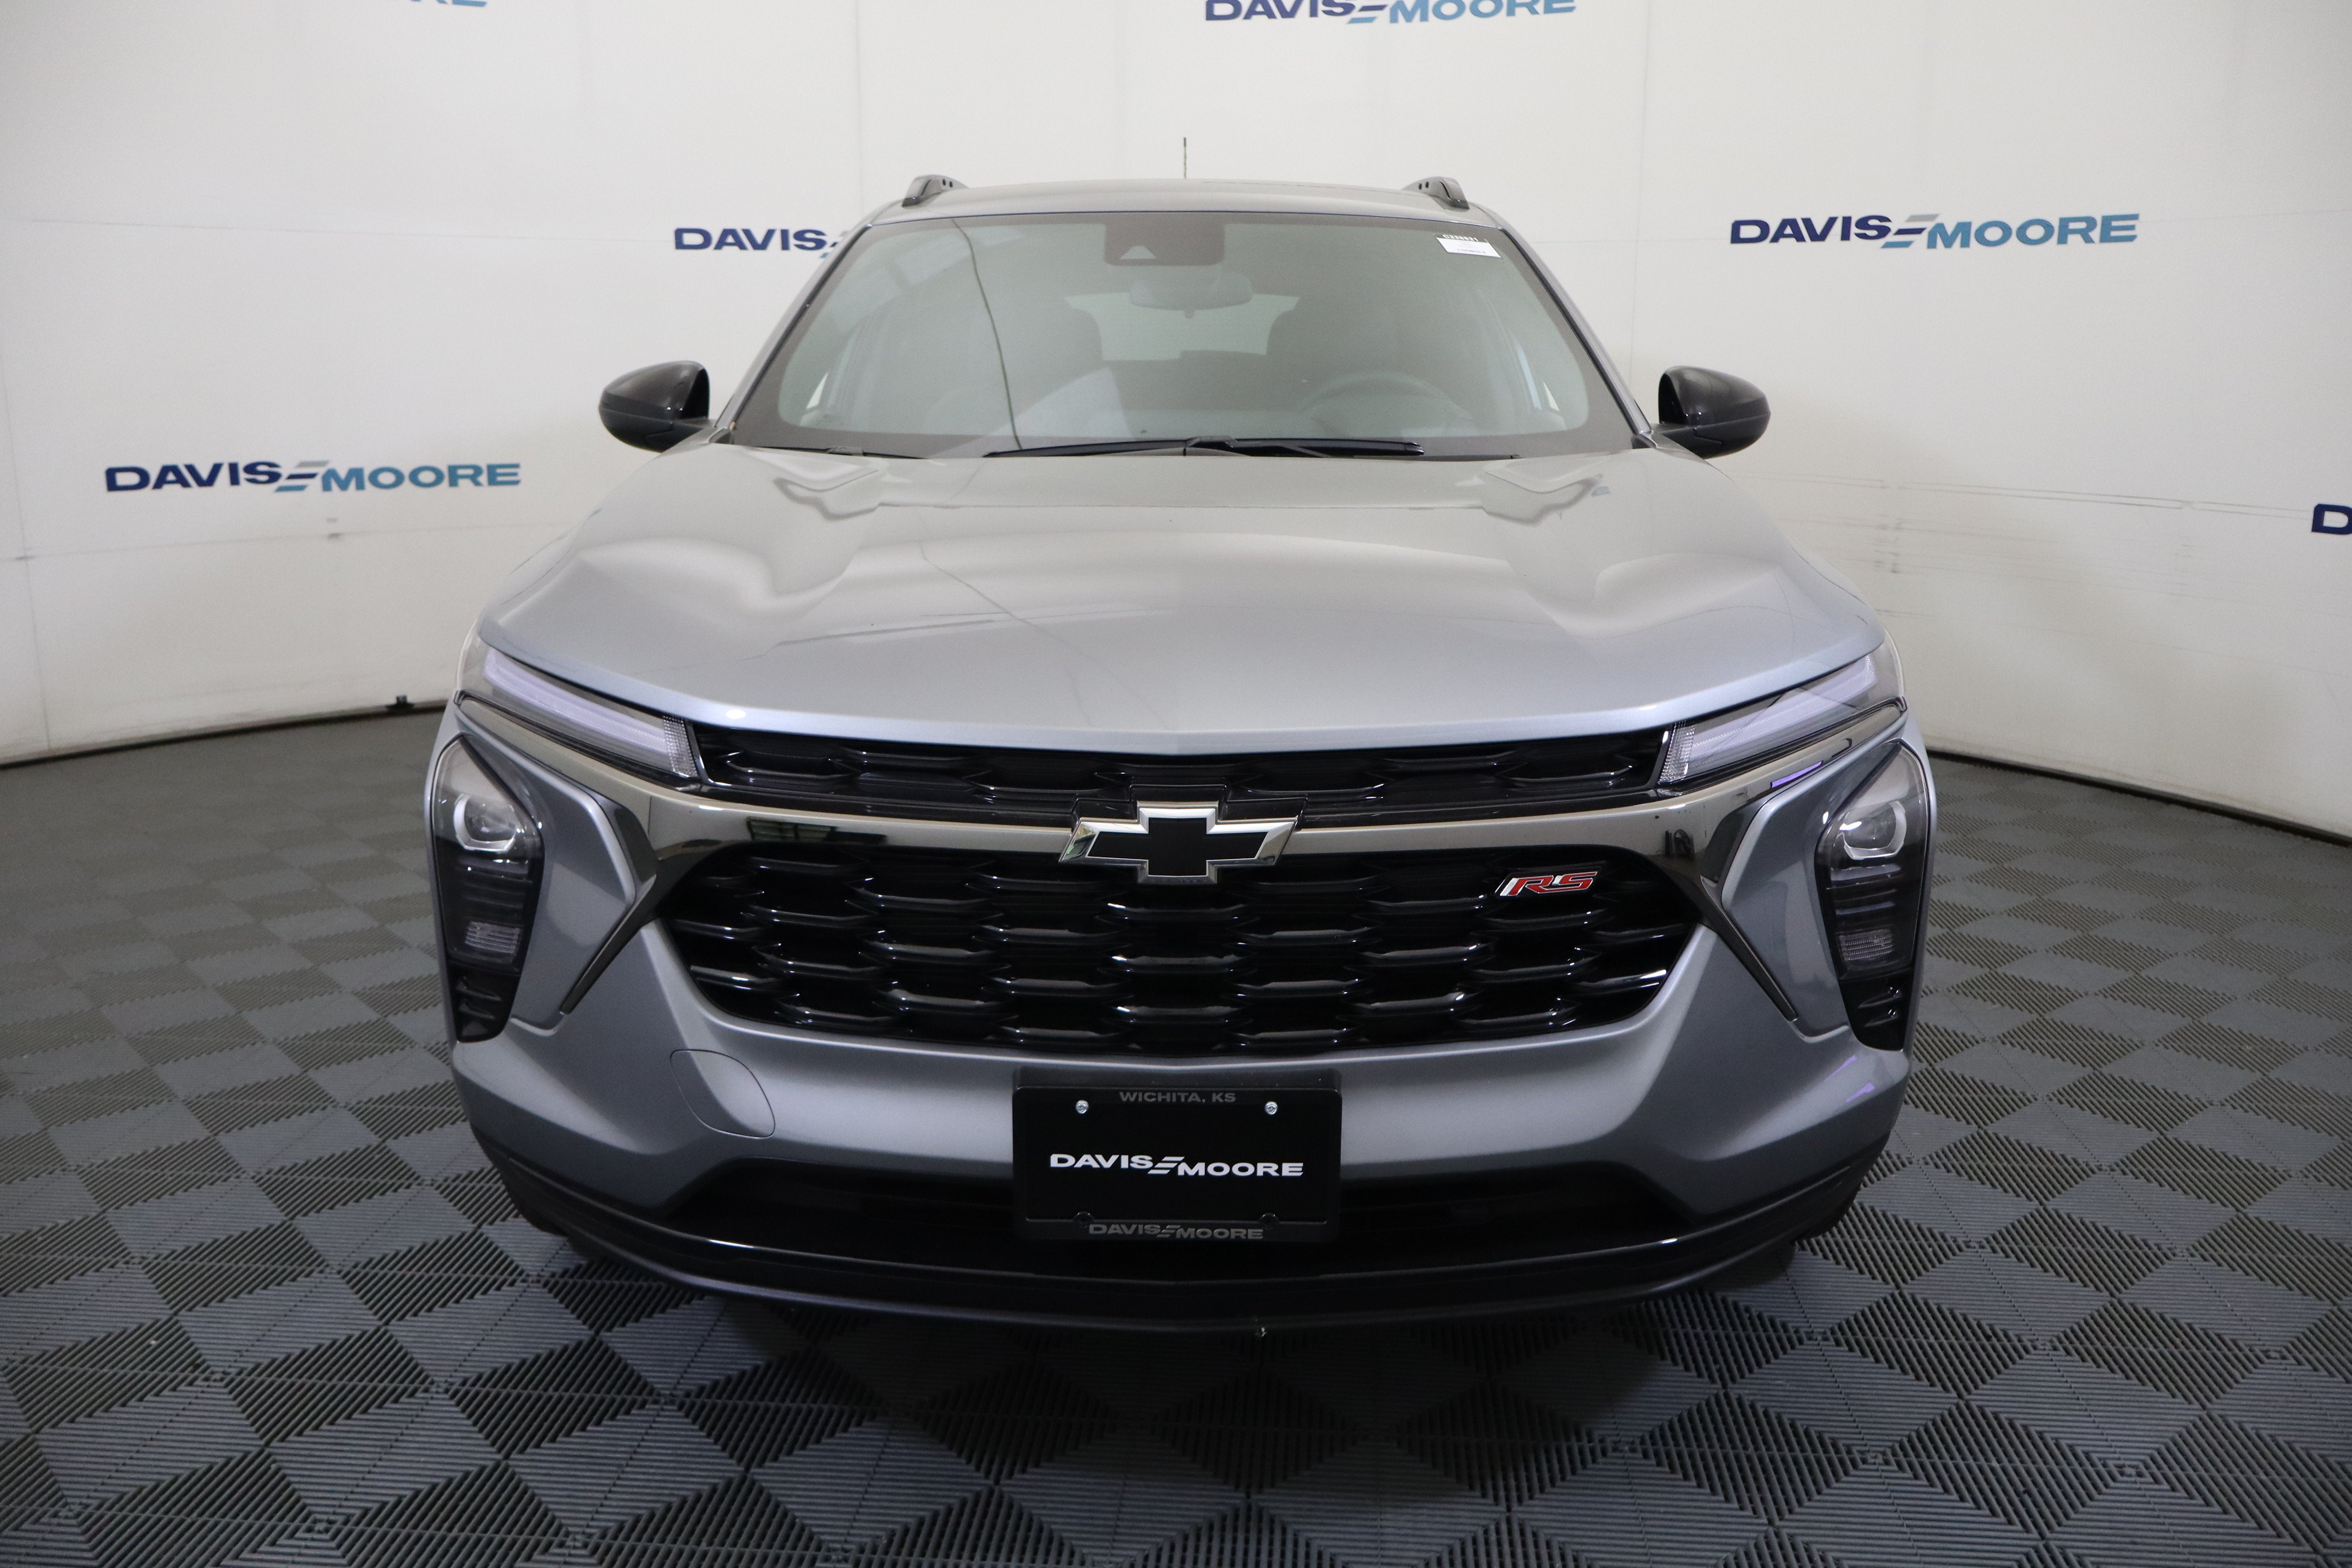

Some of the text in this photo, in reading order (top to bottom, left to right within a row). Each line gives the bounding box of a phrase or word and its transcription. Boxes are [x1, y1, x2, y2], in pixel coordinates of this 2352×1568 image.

[1205, 0, 1575, 23] DAVIS MOORE
[674, 228, 828, 251] DAVIS
[1730, 214, 2140, 249] DAVIS MOORE
[105, 461, 521, 492] DAVIS MOORE
[1500, 871, 1598, 896] RS
[1119, 1092, 1236, 1103] WICHITA, KS
[1050, 1154, 1303, 1176] DAVIS MOORE
[1089, 1223, 1263, 1240] DAVIS MOORE
